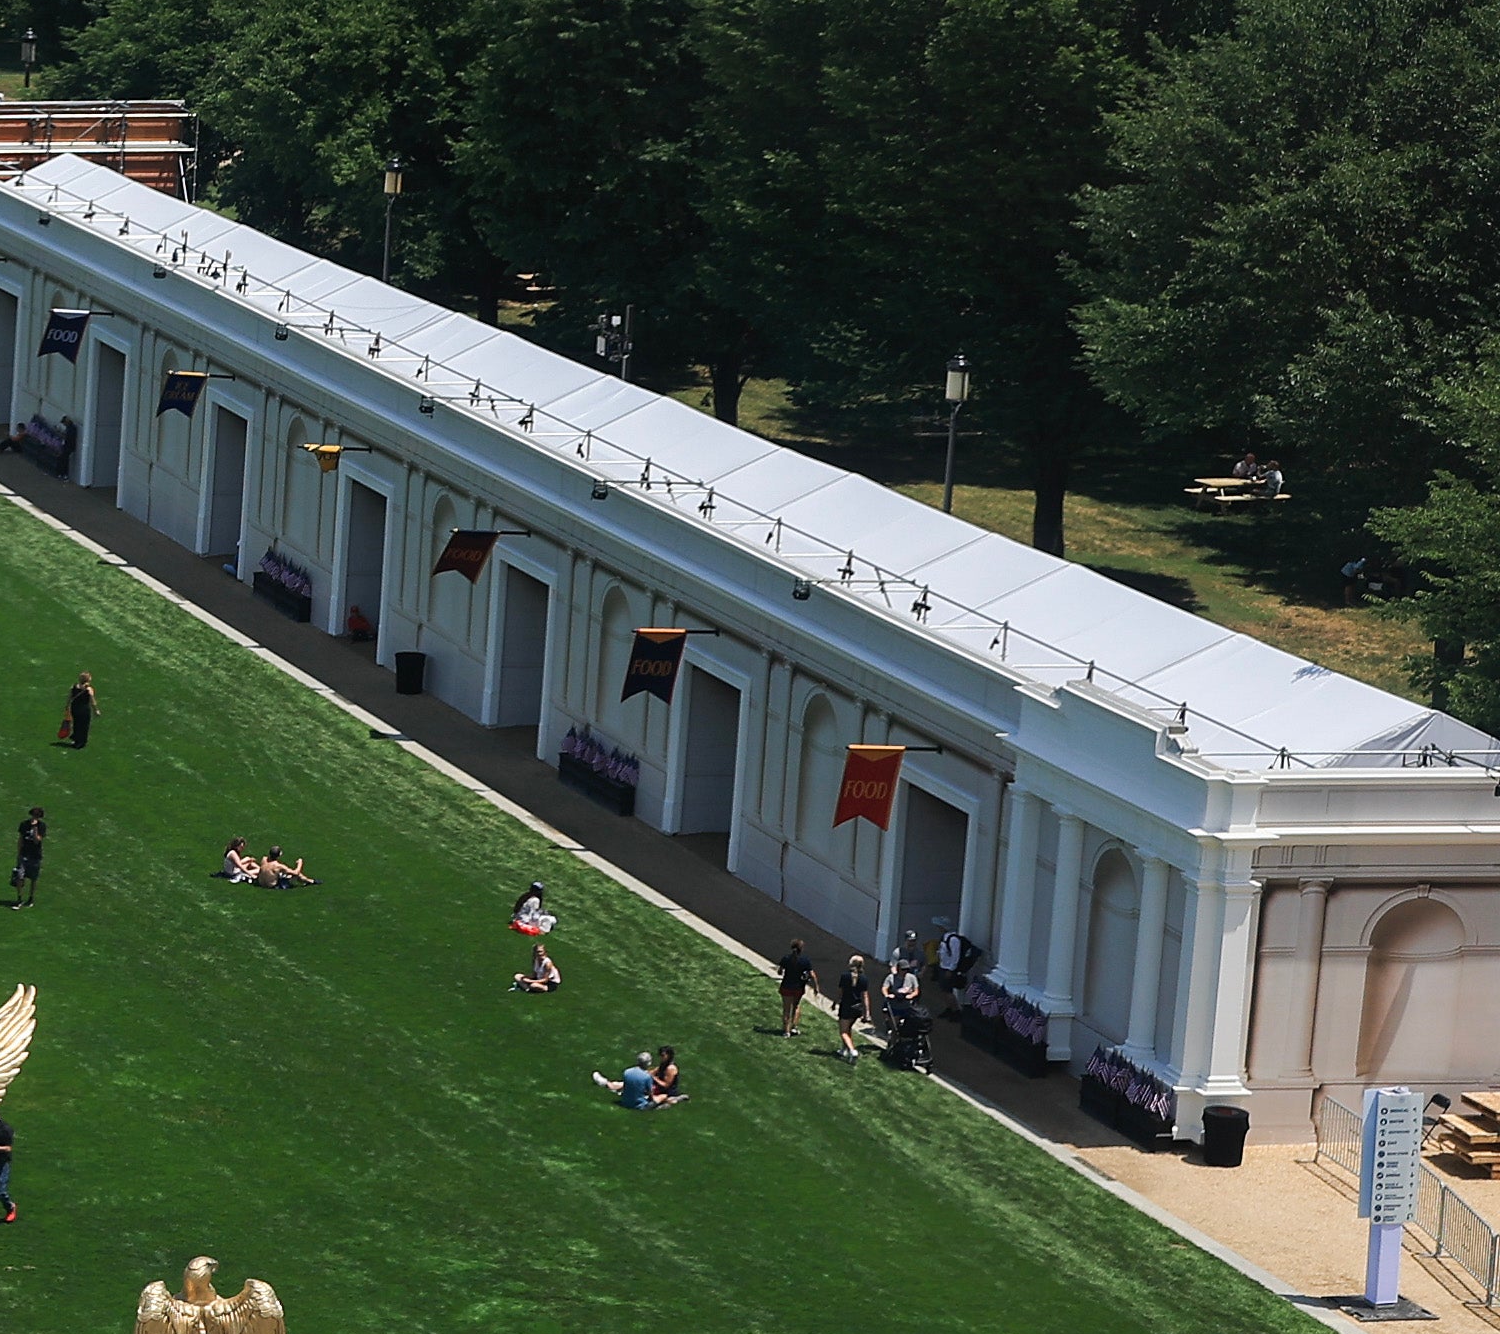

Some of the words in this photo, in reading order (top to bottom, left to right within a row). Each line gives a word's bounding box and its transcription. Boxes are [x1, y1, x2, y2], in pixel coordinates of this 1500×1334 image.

[46, 327, 78, 344] FOOD
[446, 548, 484, 562] FOOD
[630, 659, 673, 677] FOOD
[843, 780, 888, 800] FOOD
